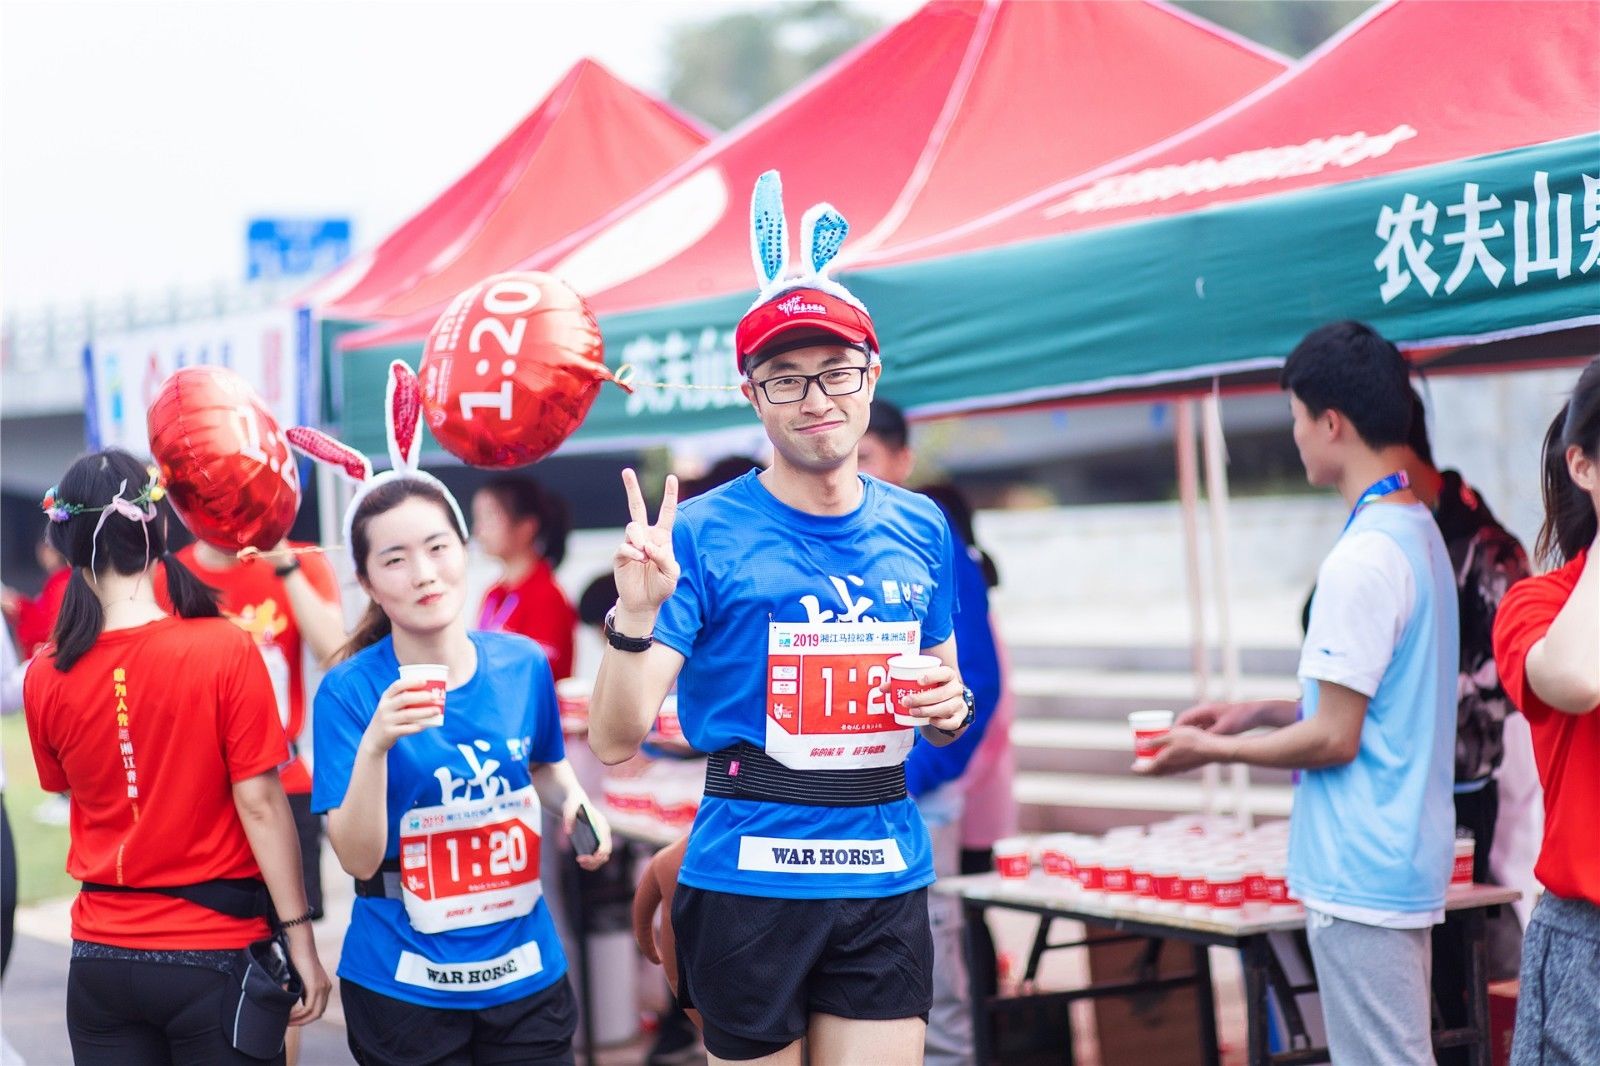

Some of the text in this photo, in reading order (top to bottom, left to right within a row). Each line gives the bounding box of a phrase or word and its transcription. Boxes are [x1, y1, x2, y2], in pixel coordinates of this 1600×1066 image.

[459, 280, 542, 421] 1:20
[446, 825, 528, 883] 1:20
[771, 847, 885, 866] WAR HORSE
[425, 960, 517, 985] WAR HORSE
